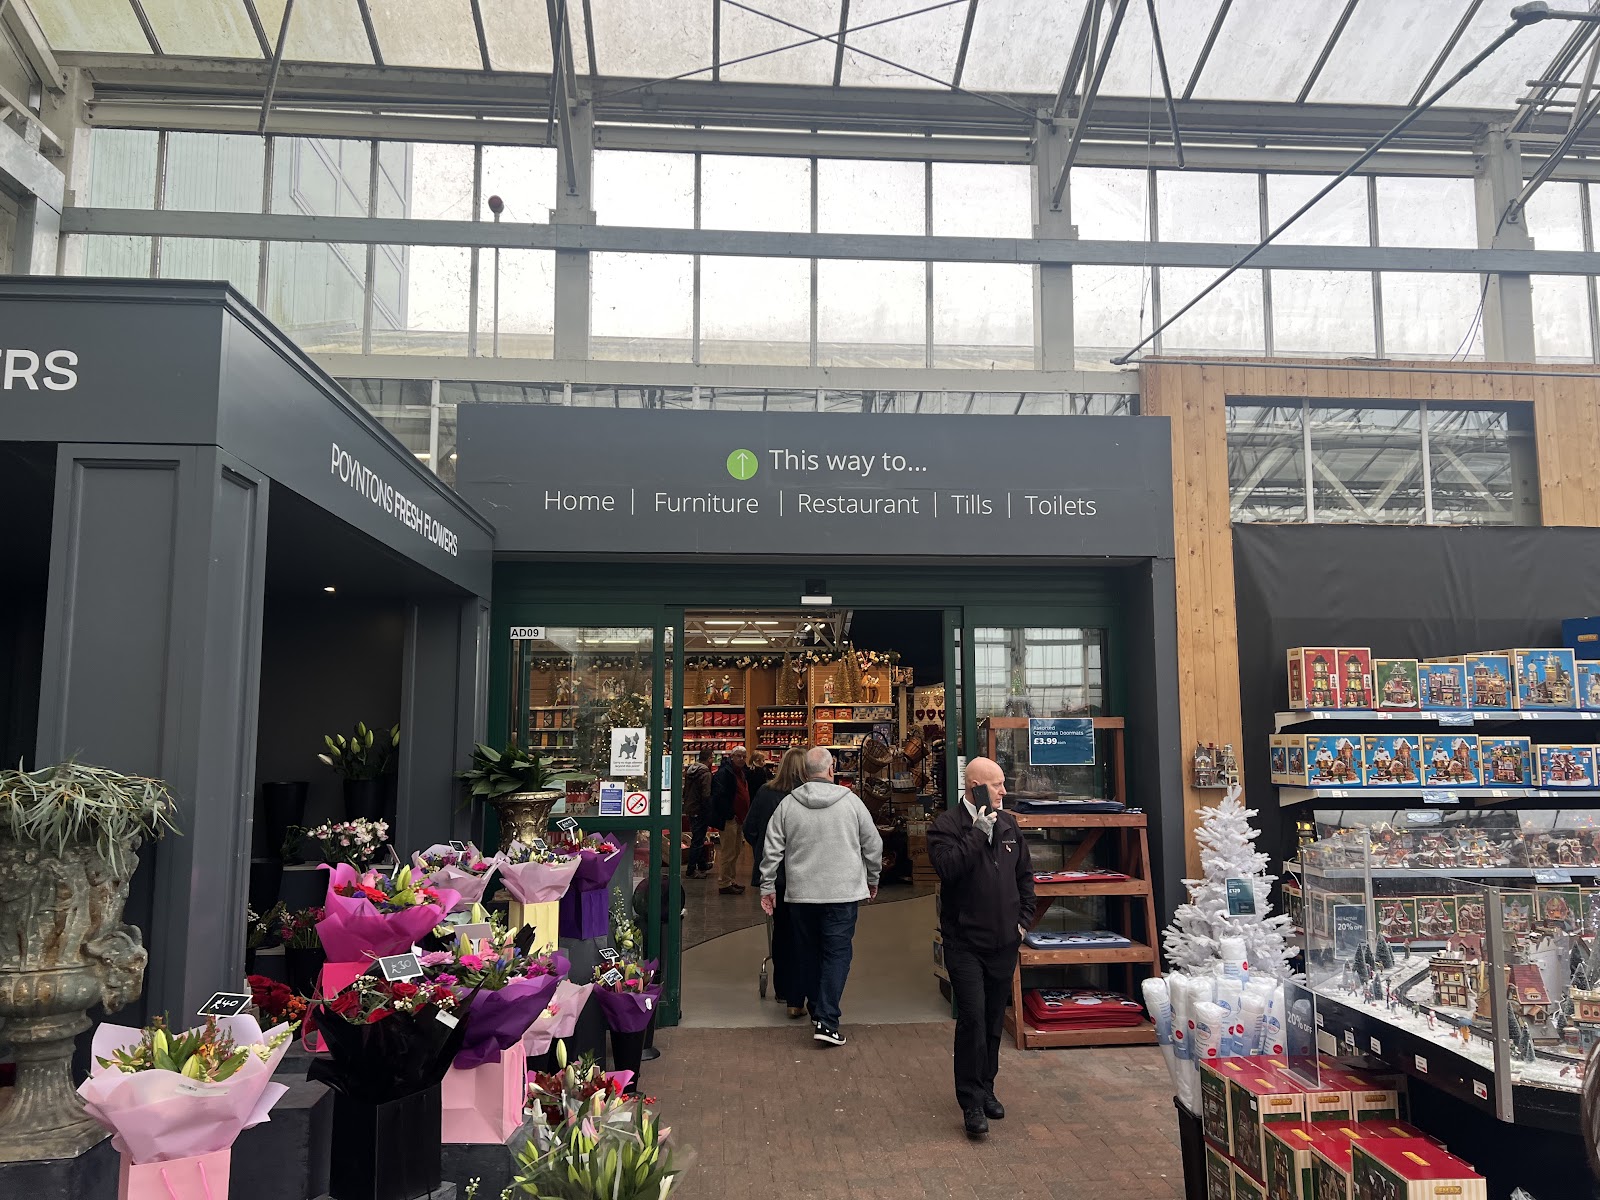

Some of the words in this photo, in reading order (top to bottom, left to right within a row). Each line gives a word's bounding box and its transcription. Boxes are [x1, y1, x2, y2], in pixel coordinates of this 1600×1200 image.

[0, 348, 78, 391] RS
[768, 448, 819, 471] This
[826, 455, 876, 477] way
[881, 452, 927, 472] to...
[330, 442, 394, 514] POYNTONS
[394, 491, 423, 535] FRESH
[423, 512, 458, 557] FLOWERS
[545, 490, 615, 511] Home
[655, 492, 759, 514] Furniture
[798, 493, 920, 514] Restaurant
[950, 494, 993, 515] Tills
[1024, 494, 1097, 516] Toilets
[511, 628, 540, 638] AD09
[1033, 737, 1058, 745] £3.99
[1337, 923, 1353, 931] 20%
[210, 997, 239, 1010] £40
[1287, 1010, 1304, 1031] 20%
